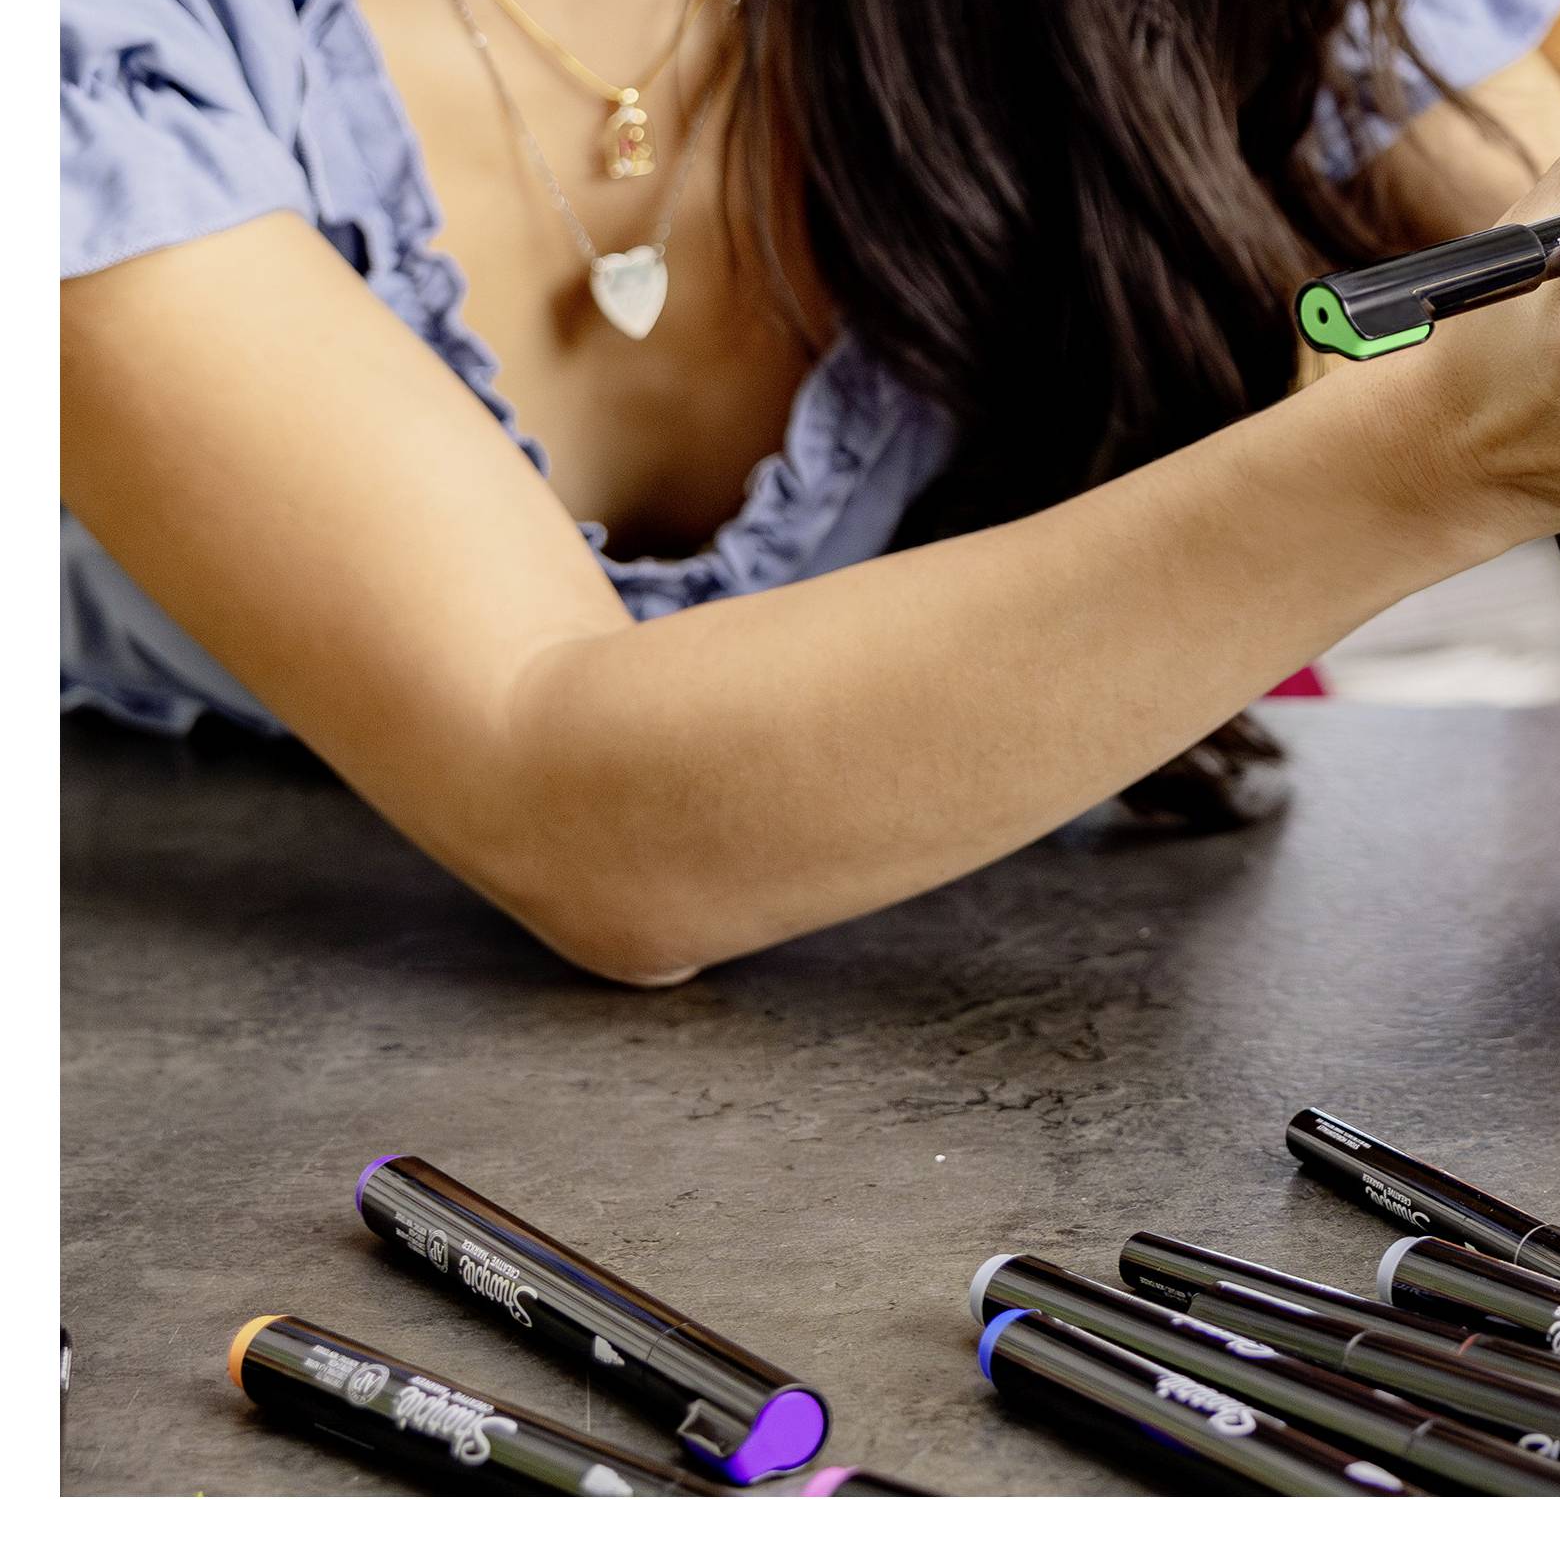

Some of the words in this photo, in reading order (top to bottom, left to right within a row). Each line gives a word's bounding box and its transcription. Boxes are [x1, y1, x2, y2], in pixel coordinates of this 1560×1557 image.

[1363, 1173, 1384, 1190] MARKER
[1387, 1187, 1411, 1206] CREATIVE
[463, 1239, 489, 1259] MARKER
[491, 1256, 520, 1279] CREATIVE
[460, 1256, 538, 1327] Sharpie
[396, 1385, 517, 1464] Sharpie
